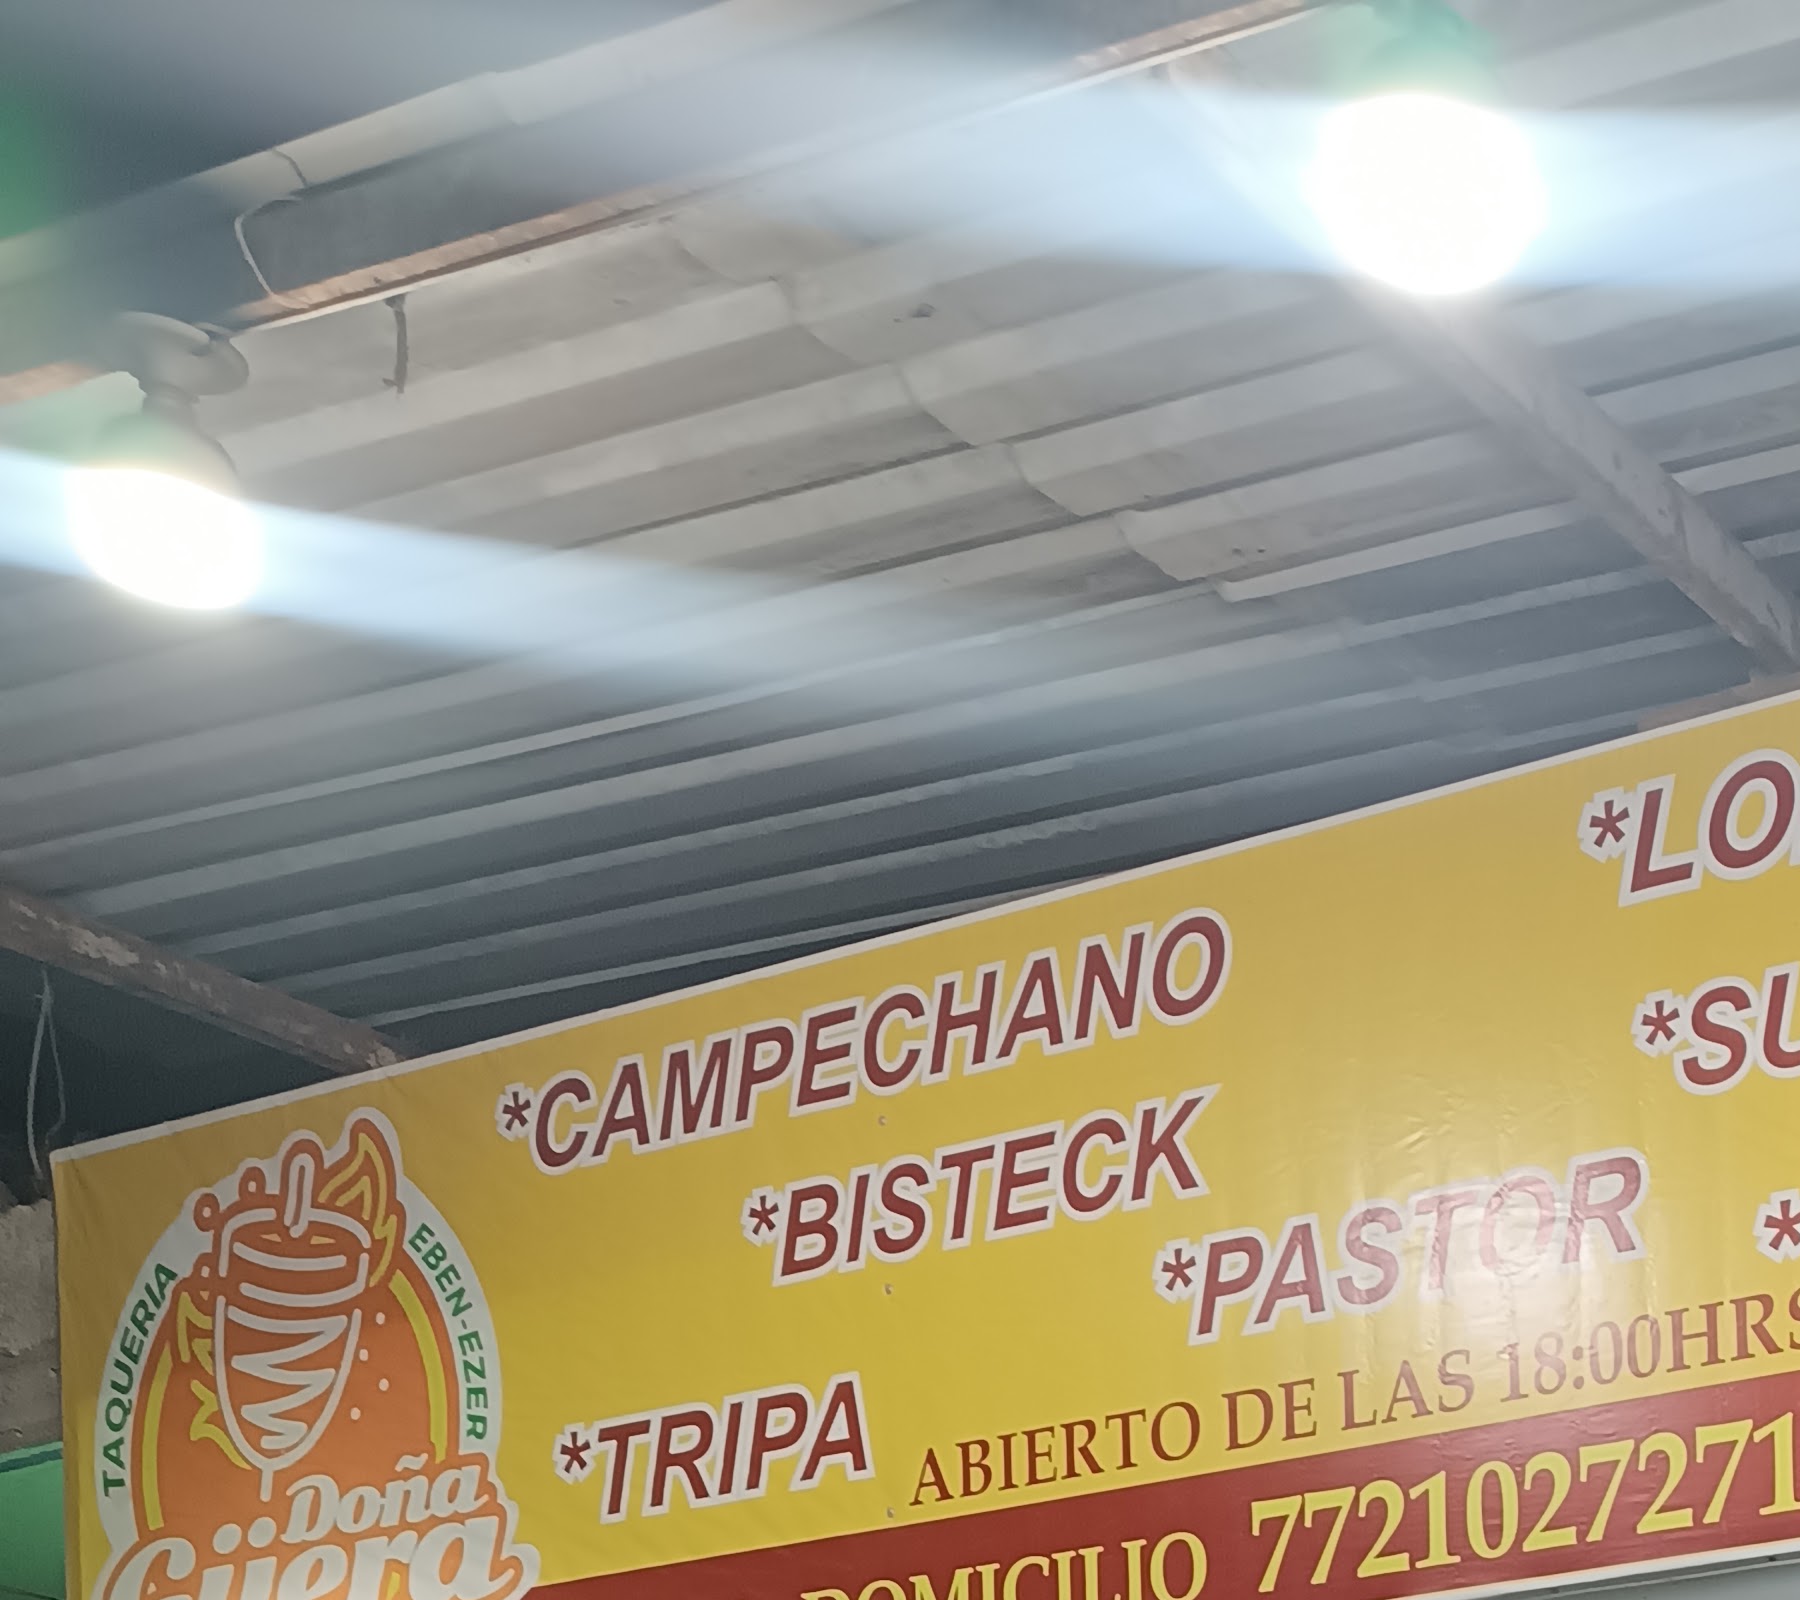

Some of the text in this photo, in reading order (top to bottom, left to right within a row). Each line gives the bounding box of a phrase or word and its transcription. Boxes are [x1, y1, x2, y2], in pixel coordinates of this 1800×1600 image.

[102, 1263, 178, 1497] TAQUERIA
[408, 1223, 488, 1442] EBEN-EZER
[281, 1456, 489, 1546] Doña
[911, 1400, 1202, 1506] ABIERTO
[1225, 1378, 1318, 1451] DE
[1338, 1349, 1475, 1431] LAS
